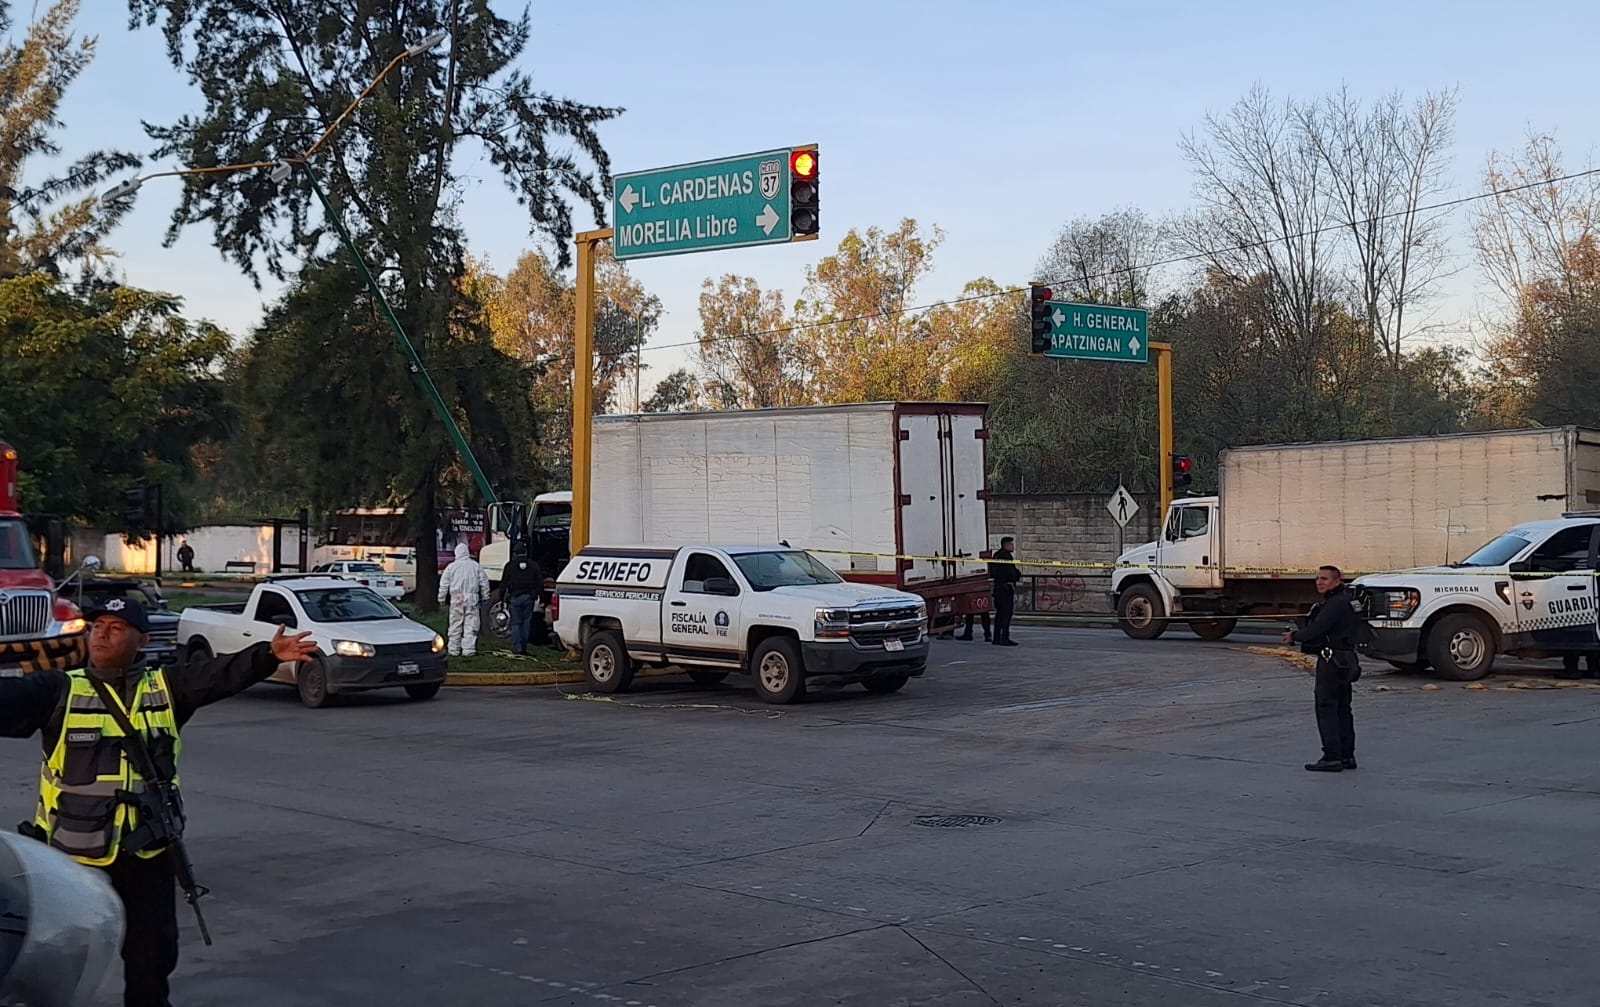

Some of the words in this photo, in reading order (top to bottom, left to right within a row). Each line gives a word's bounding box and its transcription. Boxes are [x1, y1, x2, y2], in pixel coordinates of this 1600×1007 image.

[641, 186, 655, 208] L.
[660, 171, 753, 205] CARDENAS
[763, 175, 777, 193] 37
[619, 217, 692, 247] MORELIA
[697, 214, 737, 239] Libre
[1073, 312, 1083, 327] H.
[1087, 313, 1139, 331] GENERAL
[1051, 333, 1120, 352] APATZINGAN
[576, 561, 651, 582] SEMEFO
[595, 589, 624, 598] SERVICIOS
[625, 592, 659, 601] PERICIALES
[672, 623, 709, 634] GENERAL
